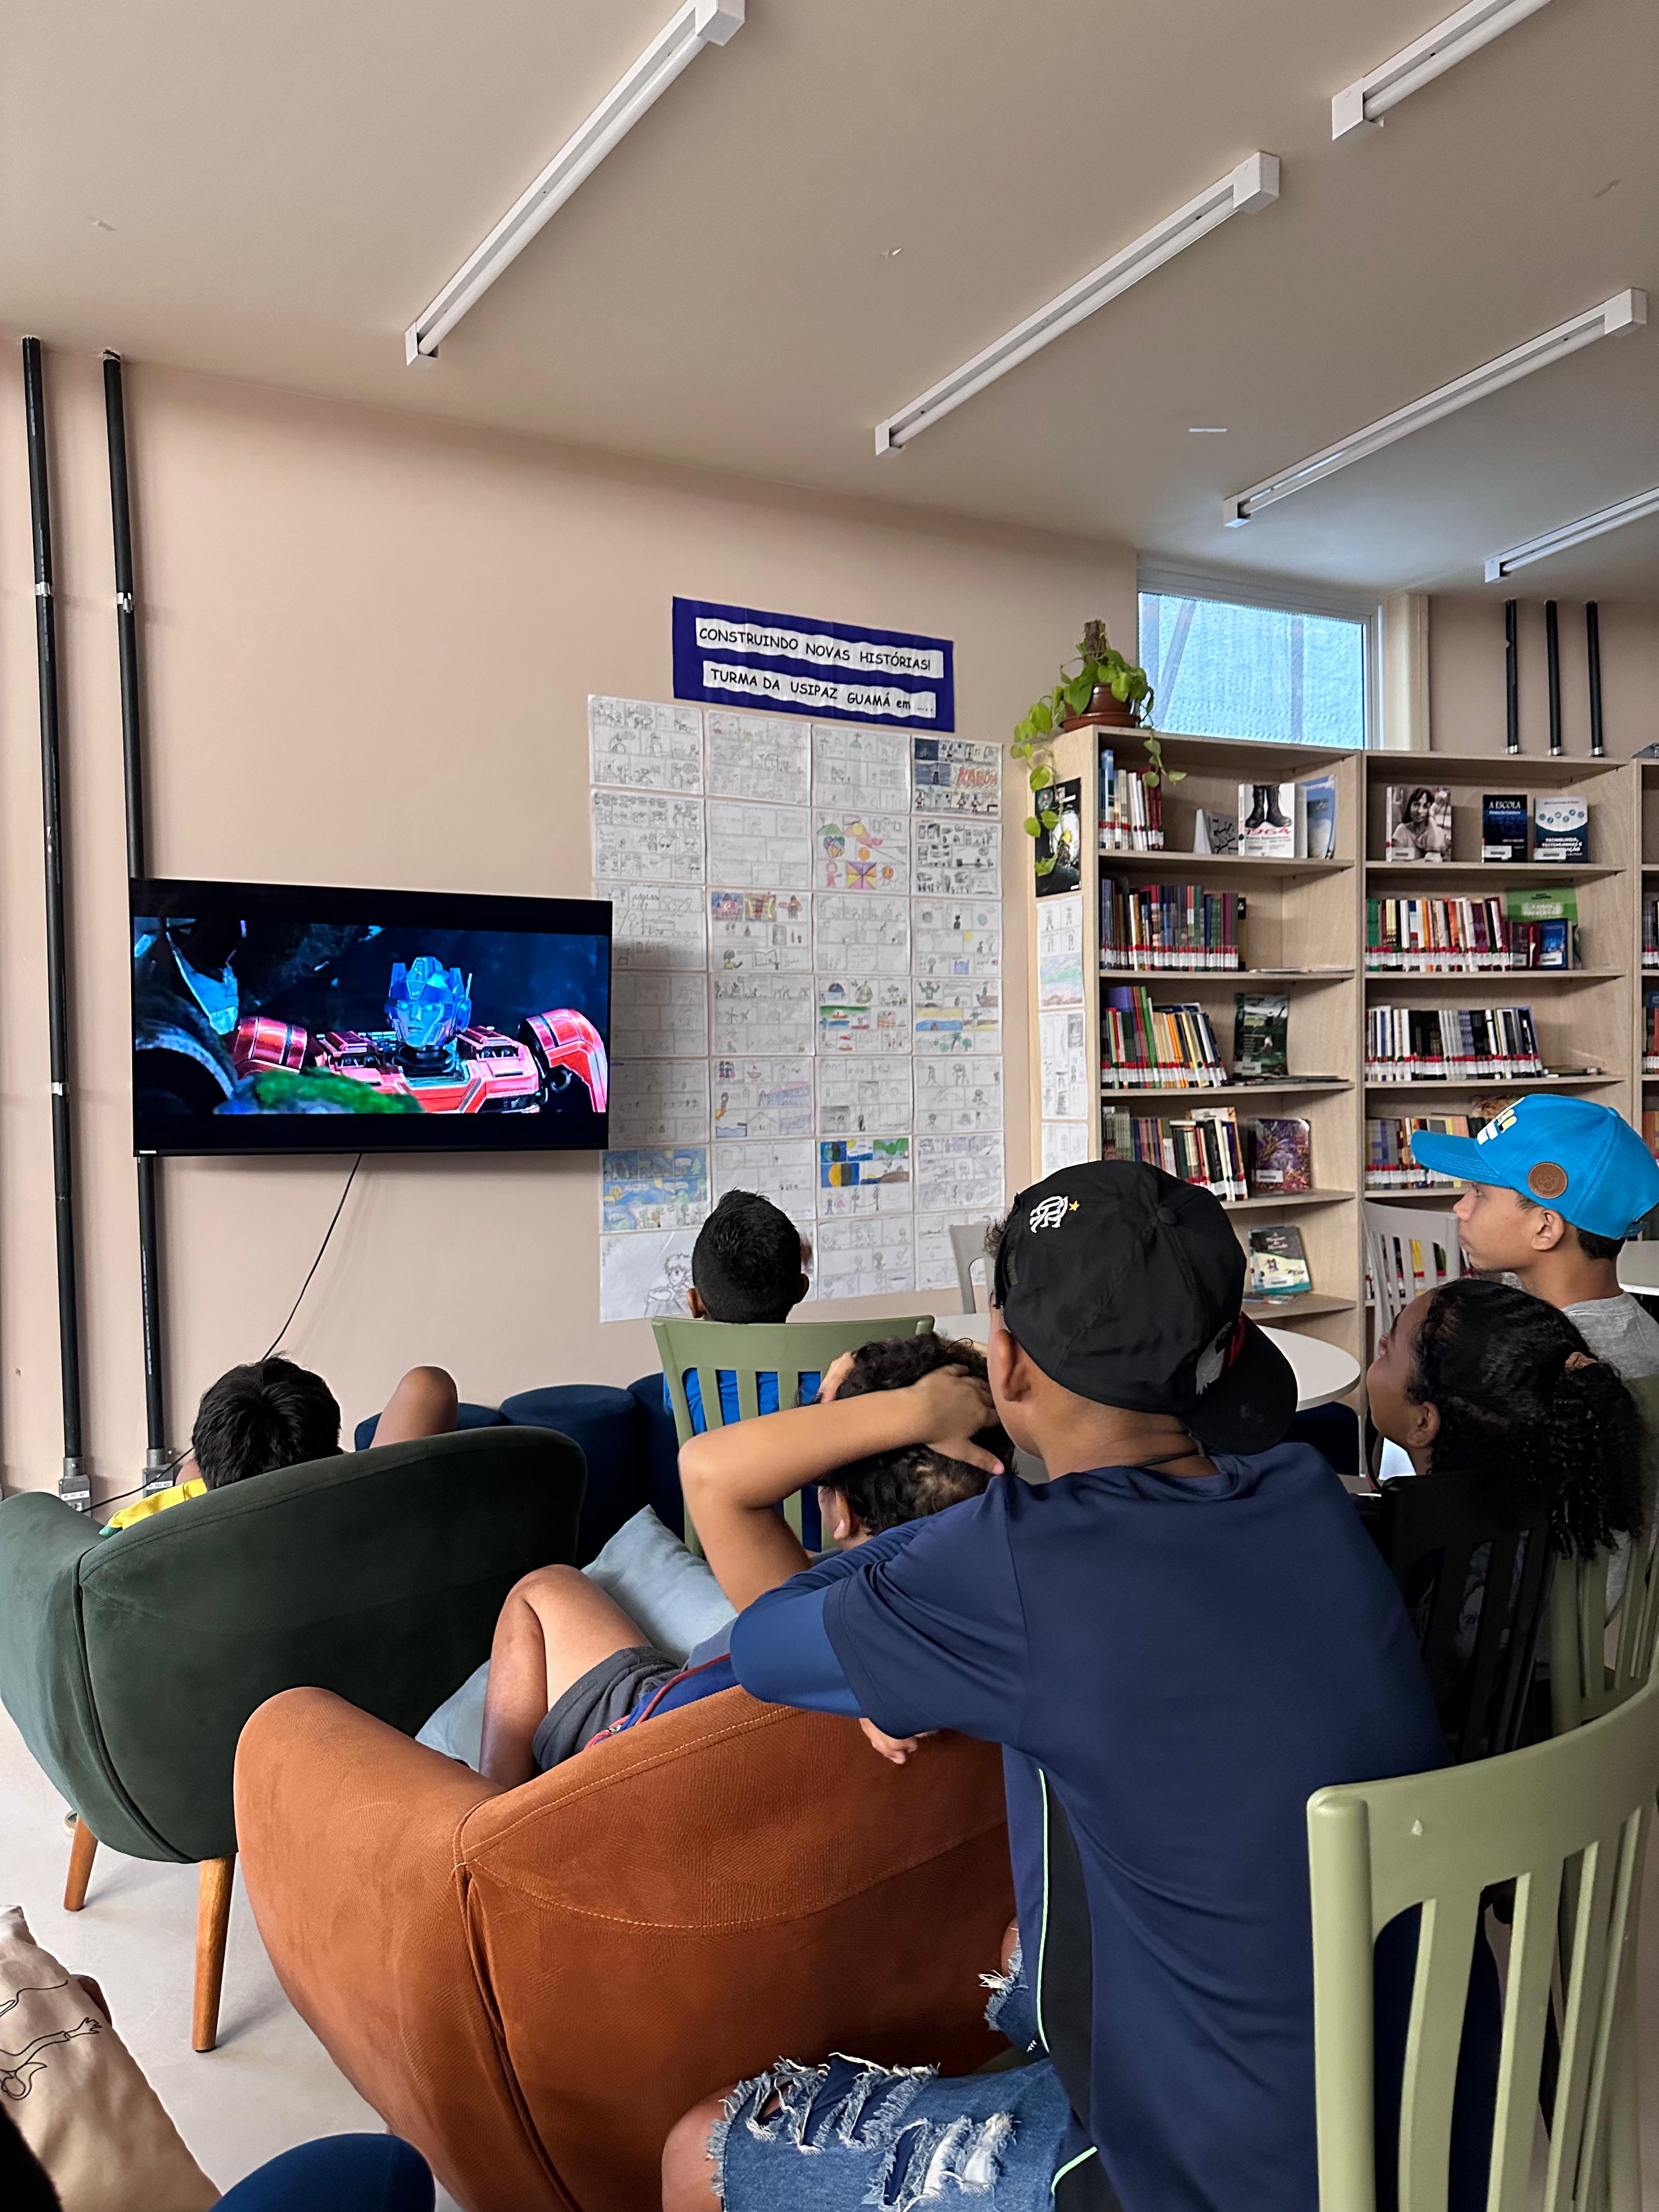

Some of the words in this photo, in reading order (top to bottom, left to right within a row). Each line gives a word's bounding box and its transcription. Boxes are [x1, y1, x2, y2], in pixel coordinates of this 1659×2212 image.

[699, 628, 798, 650] CONSTRUINDO
[805, 642, 850, 661] NOVAS
[860, 651, 931, 670] HISTÓRIAS!
[710, 668, 758, 687] TURMA
[763, 676, 780, 691] DA
[791, 681, 838, 699] USIPAZ
[847, 692, 890, 708] GUAMÁ
[896, 699, 911, 710] em
[1489, 800, 1494, 809] A
[1496, 800, 1521, 809] ESCOLA
